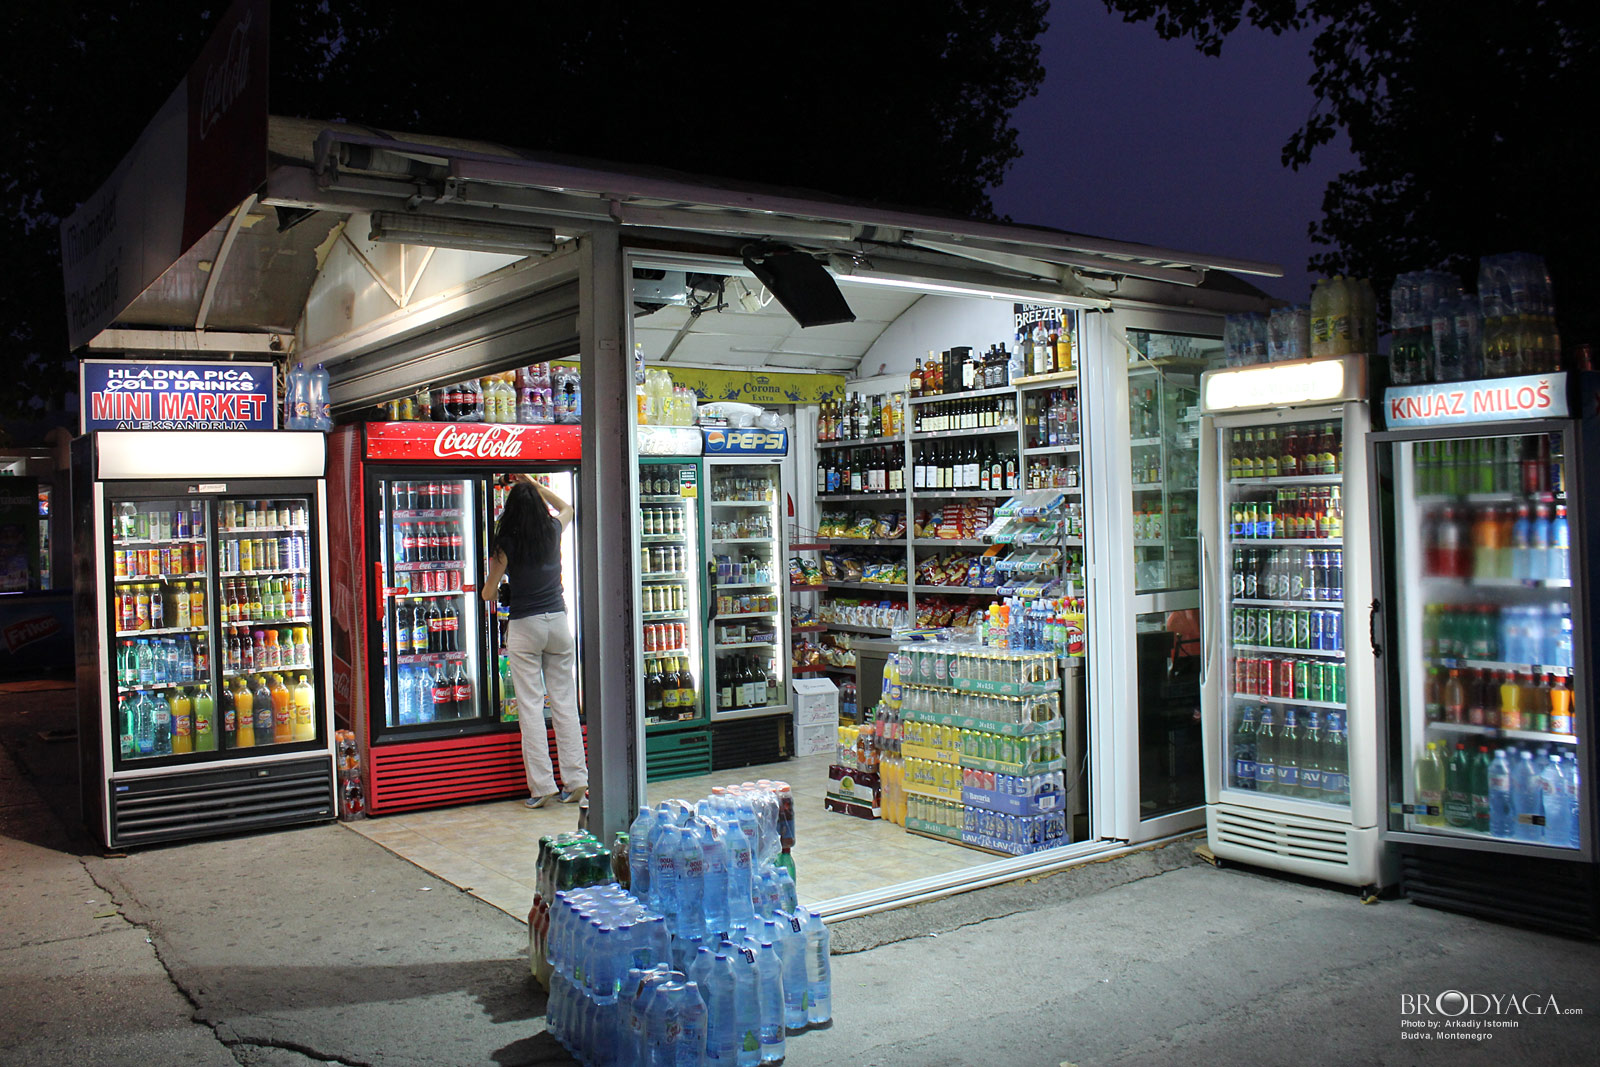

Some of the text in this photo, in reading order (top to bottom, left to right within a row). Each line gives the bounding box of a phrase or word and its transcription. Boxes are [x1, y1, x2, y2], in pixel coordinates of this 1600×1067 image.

[1015, 307, 1063, 328] BREEZER
[108, 369, 254, 381] HLADNA PIĆA
[107, 380, 254, 391] COLD DRINKS
[743, 382, 781, 394] Corona
[1391, 380, 1551, 419] KNJAZ MILOŠ
[92, 393, 267, 421] MINI MARKET
[116, 420, 248, 430] ALEKSANDRIJA
[434, 424, 526, 458] Coca-Cola
[726, 433, 784, 449] PEPSI
[969, 792, 990, 802] Bavaria
[962, 833, 978, 843] LAV
[993, 840, 1009, 850] LAV
